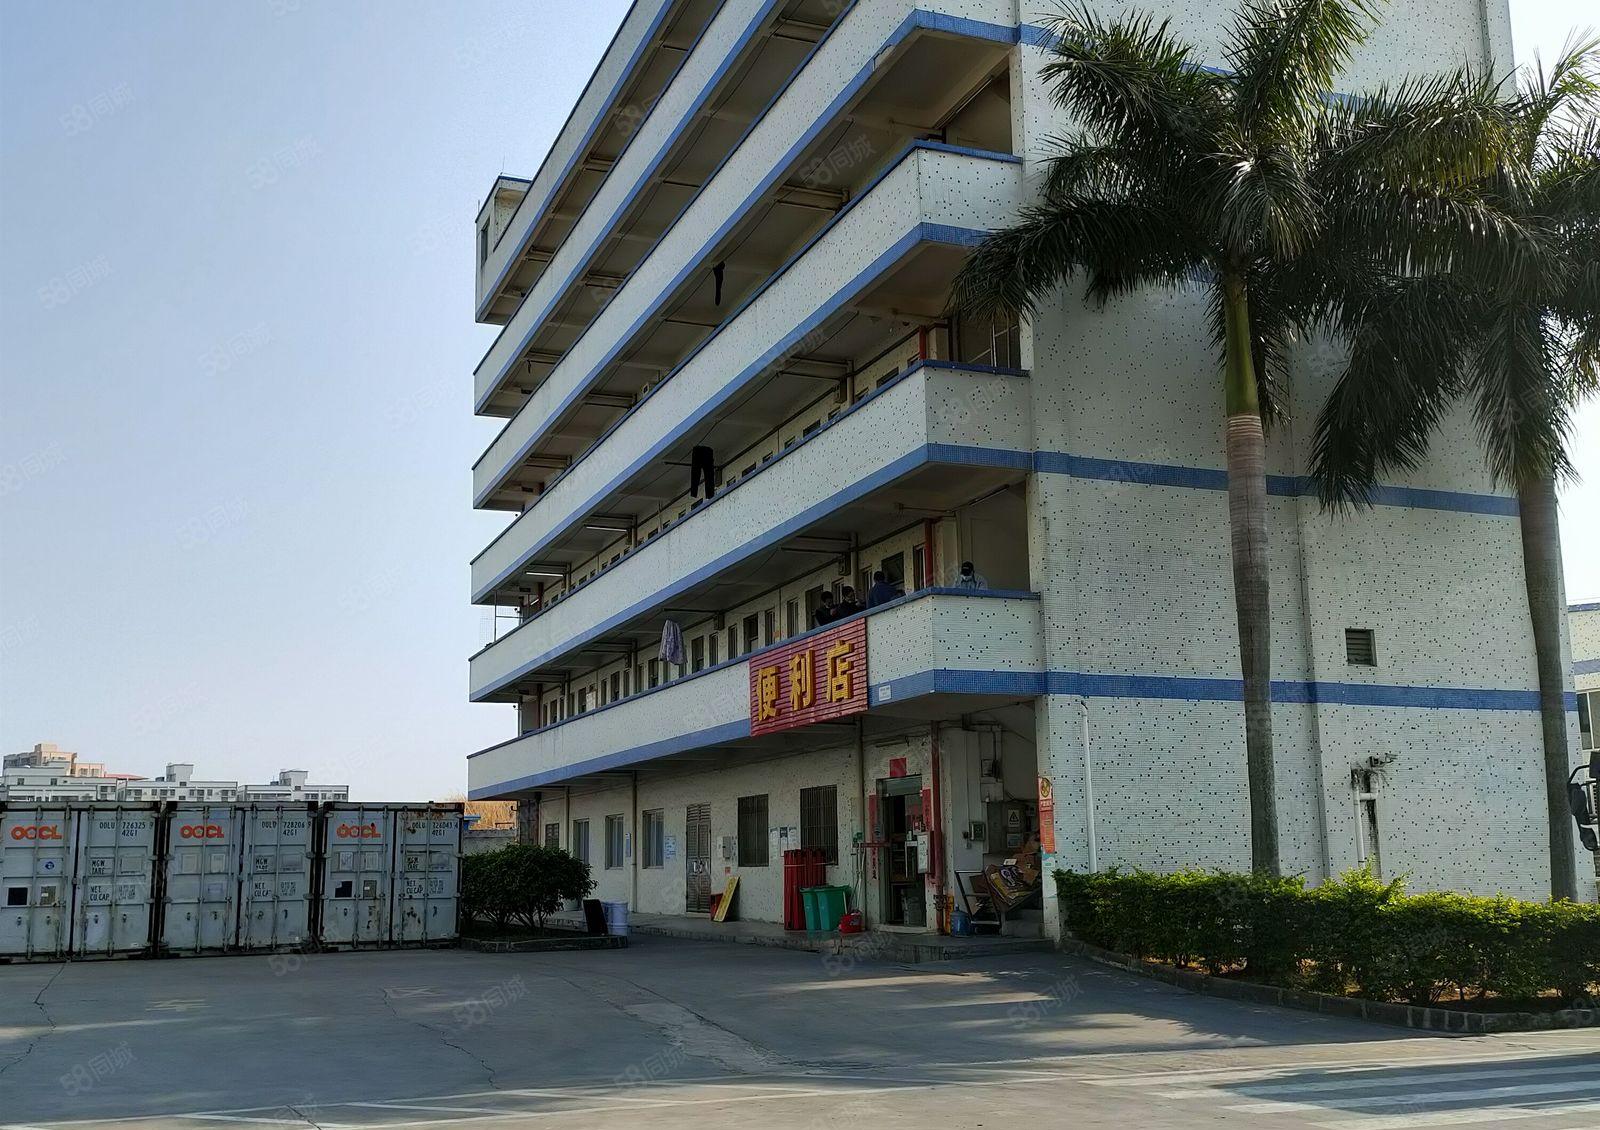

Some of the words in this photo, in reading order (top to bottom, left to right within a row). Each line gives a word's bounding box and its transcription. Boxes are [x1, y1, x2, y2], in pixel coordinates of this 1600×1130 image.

[755, 639, 854, 721] 便利店
[11, 825, 62, 840] OOCL
[180, 824, 225, 839] OOCL
